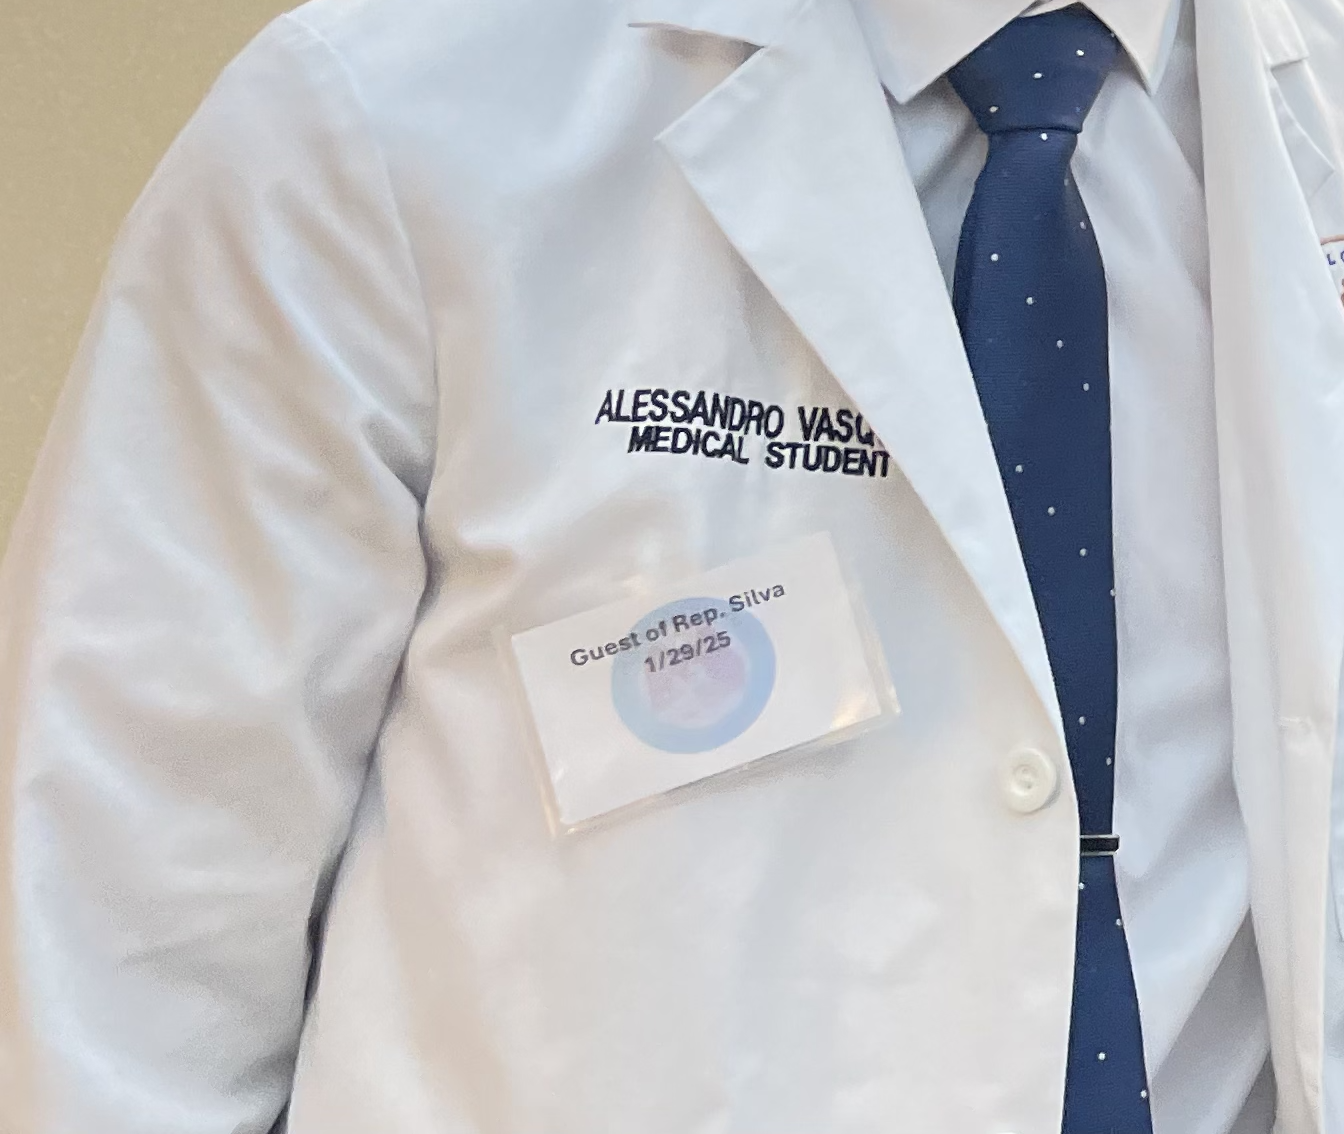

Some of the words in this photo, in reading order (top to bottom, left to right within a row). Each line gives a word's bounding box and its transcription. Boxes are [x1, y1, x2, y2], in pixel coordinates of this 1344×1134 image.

[595, 388, 785, 439] ALESSANDRO
[797, 405, 886, 447] VASQ
[628, 425, 750, 465] MEDICAL
[764, 440, 891, 478] STUDENT
[570, 632, 642, 666] Guest
[645, 620, 668, 642] of
[672, 607, 726, 633] Rep.
[728, 584, 785, 613] Silva
[643, 630, 732, 673] 1/29/25
